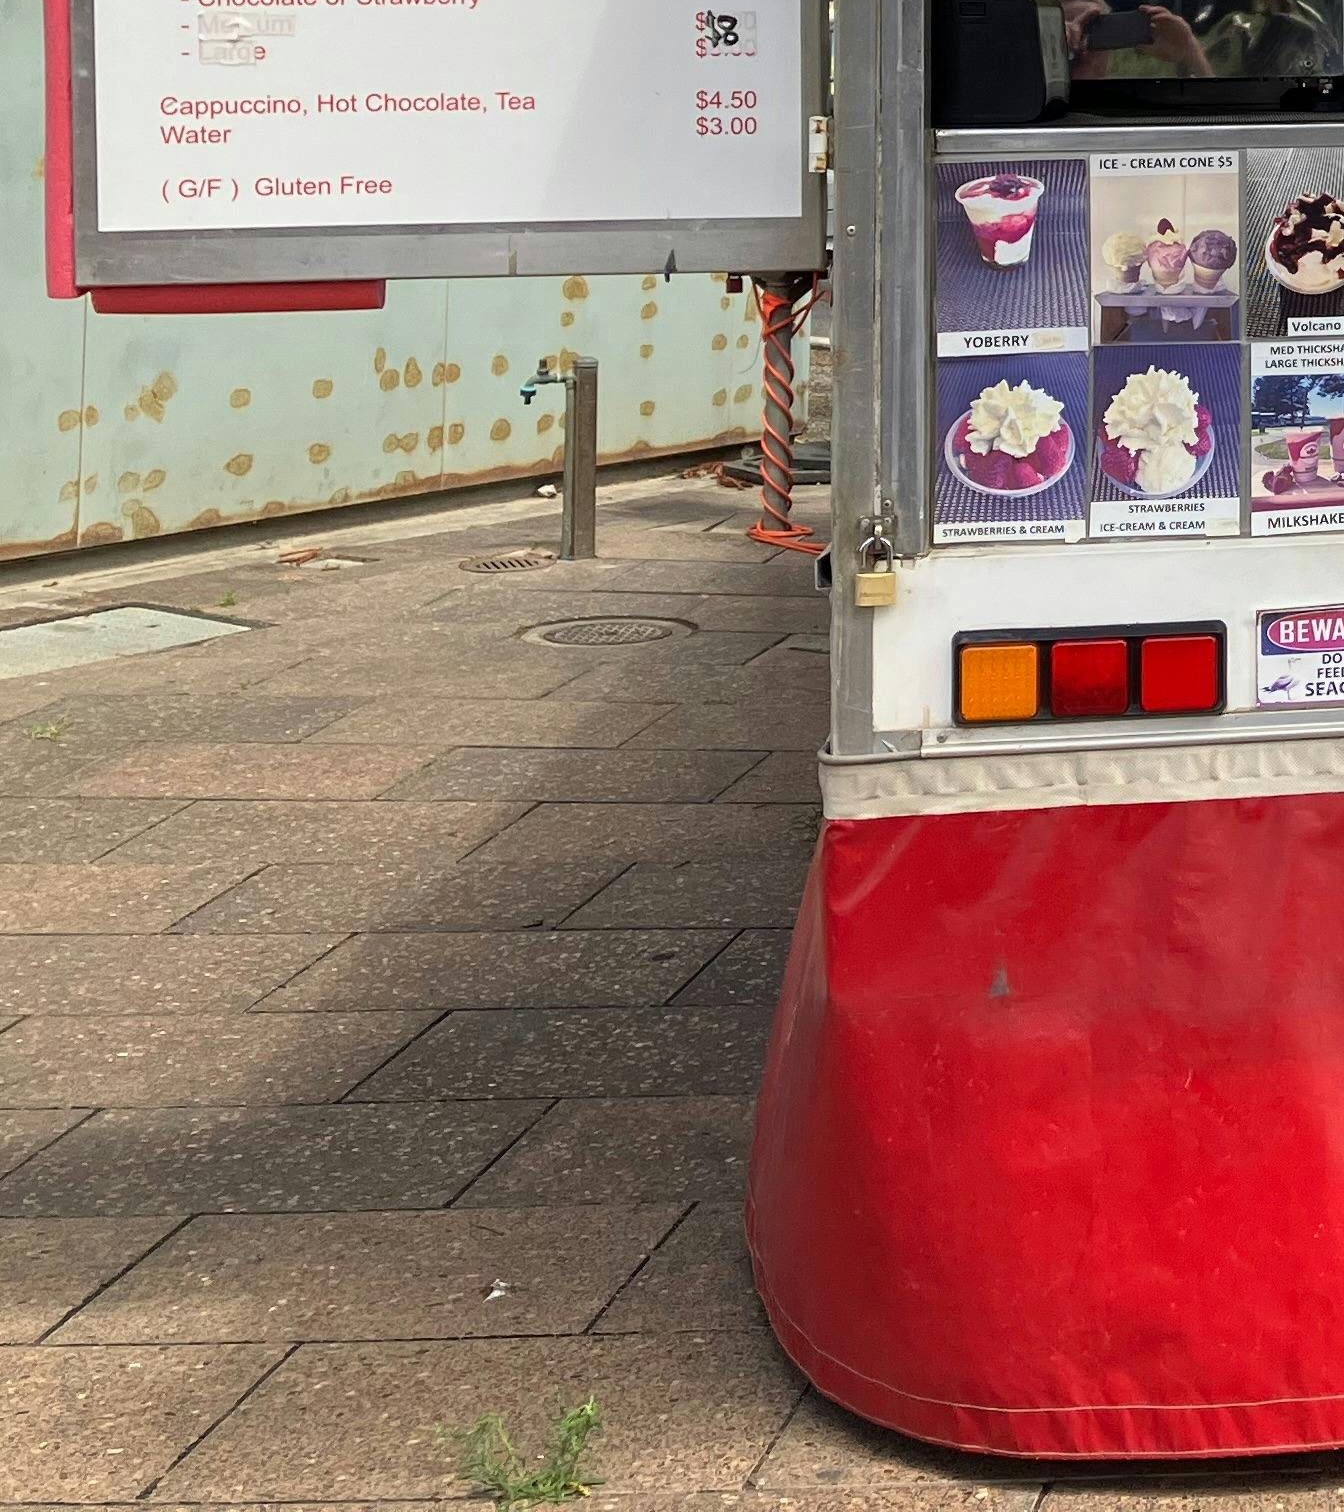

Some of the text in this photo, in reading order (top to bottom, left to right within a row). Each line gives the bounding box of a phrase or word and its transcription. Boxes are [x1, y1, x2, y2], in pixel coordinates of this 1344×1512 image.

[1100, 158, 1118, 170] ICE
[1130, 158, 1176, 169] CREAM
[1179, 157, 1214, 168] CONE
[1218, 155, 1232, 168] $5
[1292, 320, 1341, 332] Volcano
[964, 335, 1030, 348] YOBERRY
[1270, 346, 1294, 355] MED
[1265, 359, 1298, 368] LARGE
[1128, 502, 1205, 514] STRAWBERRIES
[942, 525, 1064, 538] STRAWBERRIES & CREAM
[1100, 520, 1205, 532] ICE-CREAM & CREAM
[1322, 652, 1343, 665] DO
